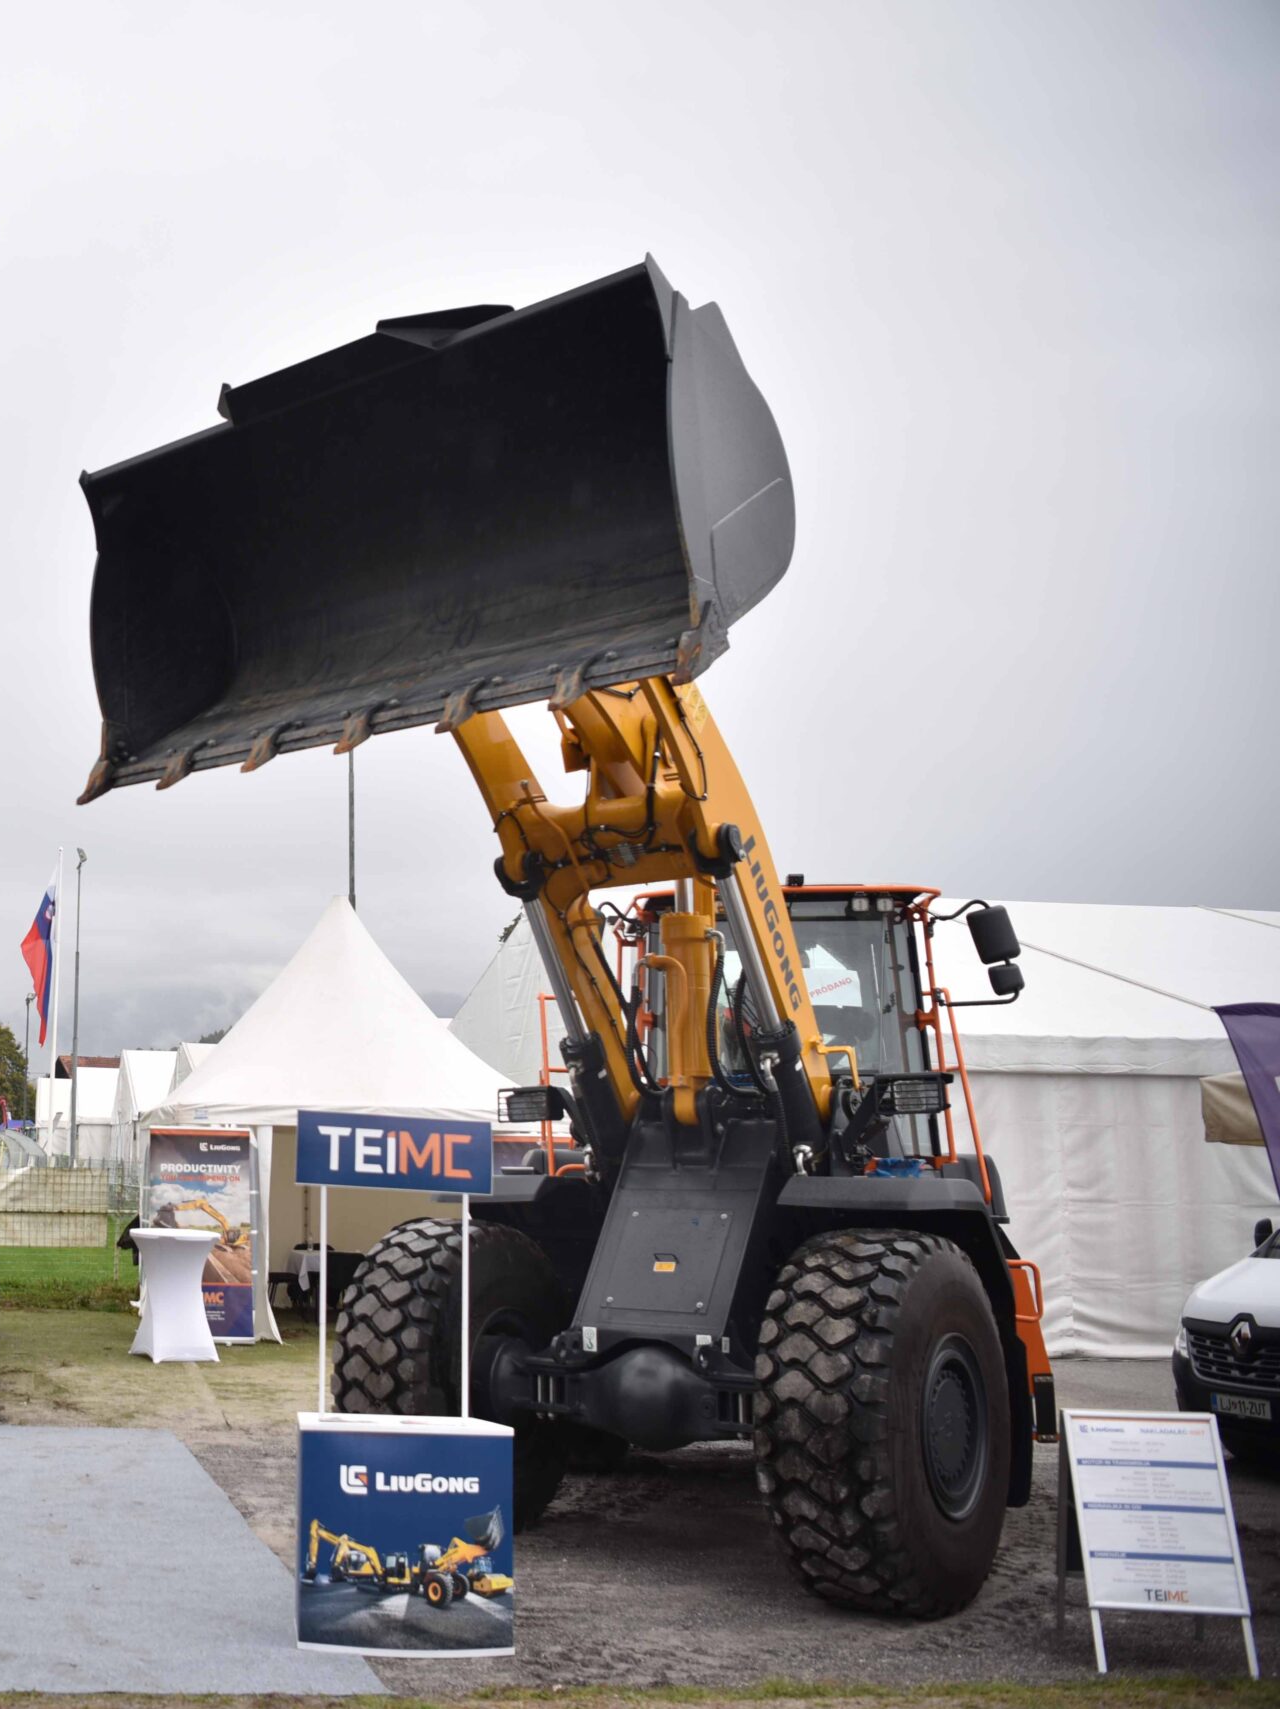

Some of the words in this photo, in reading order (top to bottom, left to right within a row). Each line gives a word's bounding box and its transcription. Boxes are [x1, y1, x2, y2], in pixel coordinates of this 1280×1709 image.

[810, 977, 853, 998] PRODANO
[160, 1163, 241, 1174] PRODUCTIVITY
[1144, 1588, 1190, 1603] TEIMC
